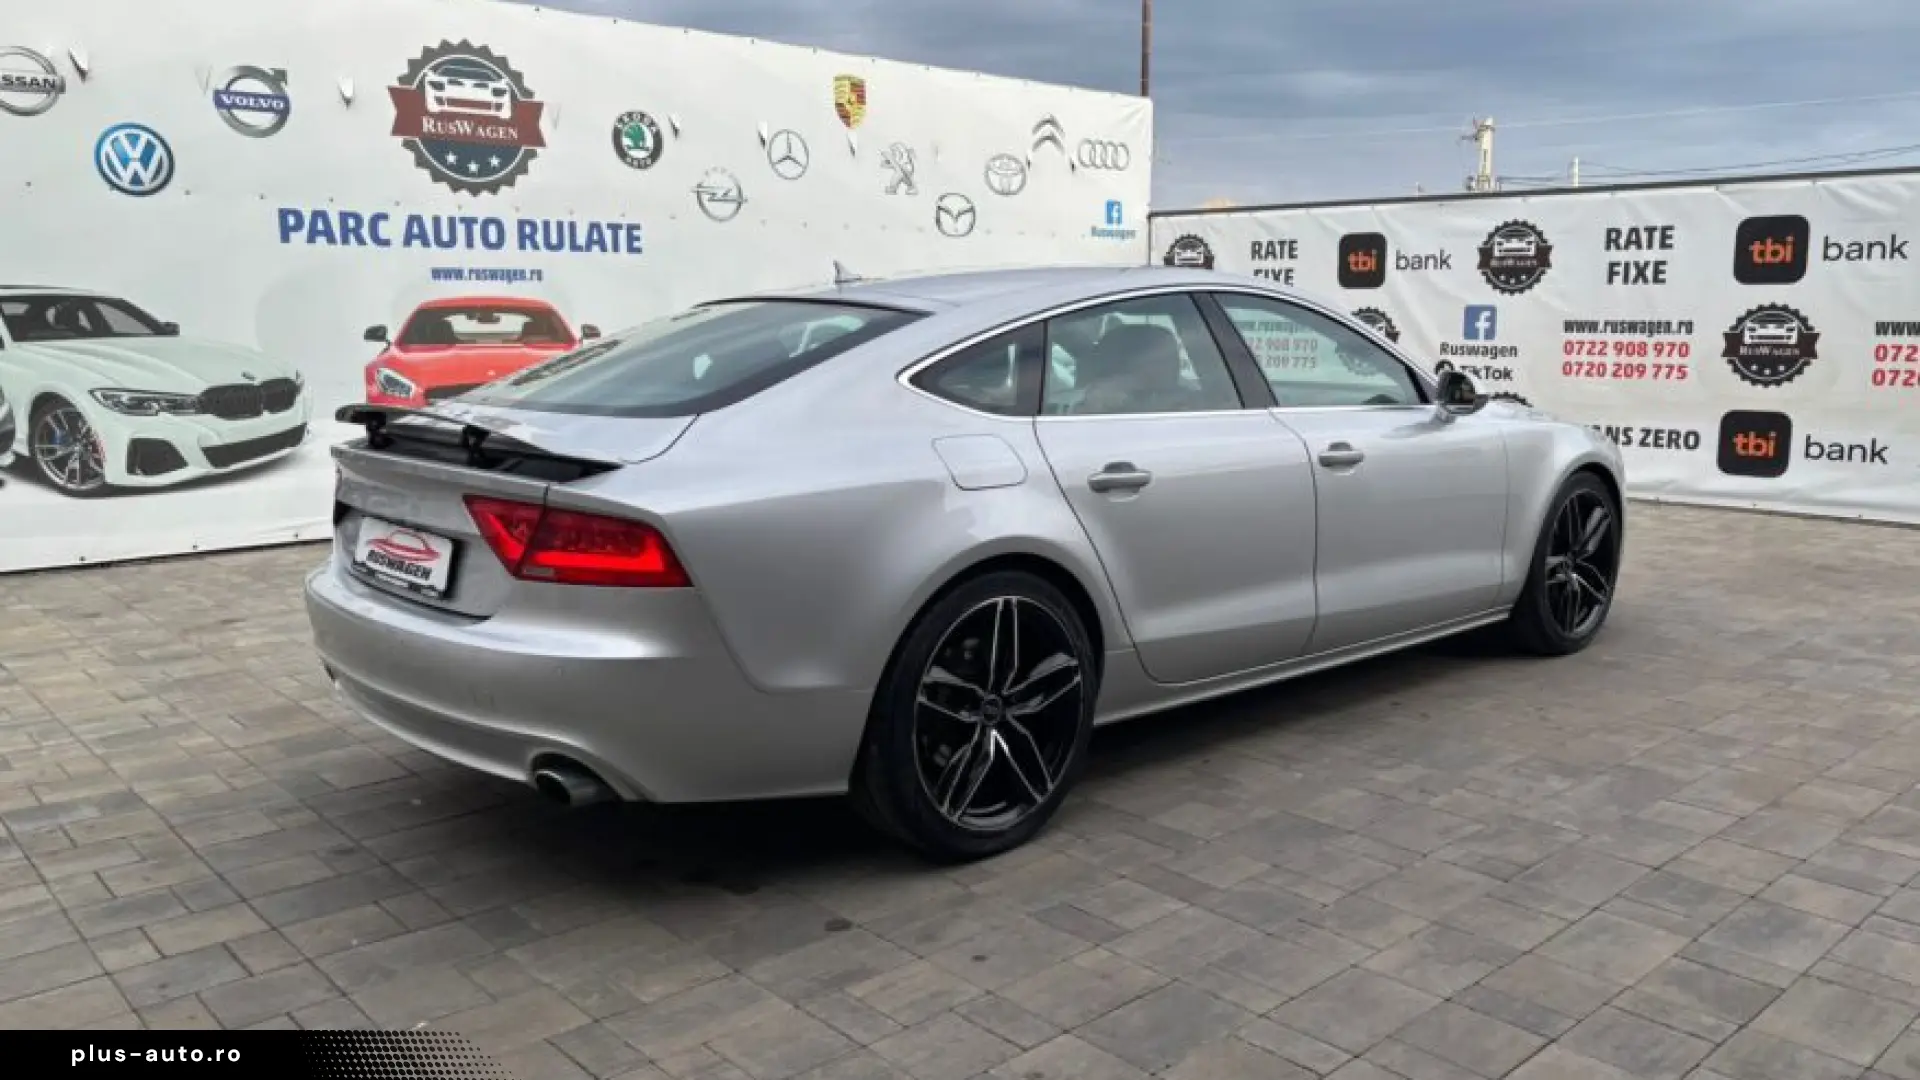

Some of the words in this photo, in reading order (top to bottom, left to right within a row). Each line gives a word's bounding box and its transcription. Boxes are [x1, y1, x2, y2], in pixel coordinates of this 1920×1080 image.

[219, 93, 285, 110] VOLVO
[278, 207, 391, 247] PARC
[403, 214, 505, 251] AUTO
[517, 218, 643, 254] RULATE
[1604, 225, 1675, 251] RATE
[1251, 239, 1299, 260] RATE
[1749, 234, 1795, 264] tbi
[1823, 234, 1909, 262] bank
[1348, 249, 1378, 273] tbi
[1396, 249, 1452, 271] bank
[431, 267, 542, 284] www.ruswagen.ro
[1606, 260, 1668, 285] FIXE
[1564, 320, 1694, 337] www.ruswagen.ro
[1440, 342, 1518, 360] Ruswagen
[1563, 340, 1608, 356] 0722
[1612, 341, 1648, 358] 908
[1653, 341, 1691, 358] 970
[1562, 362, 1607, 378] 0720
[1612, 362, 1648, 379] 209
[1652, 363, 1689, 380] 775
[1872, 369, 1920, 387] 072
[1638, 427, 1702, 451] ZERO
[1733, 431, 1777, 458] tbi
[1804, 435, 1888, 465] bank
